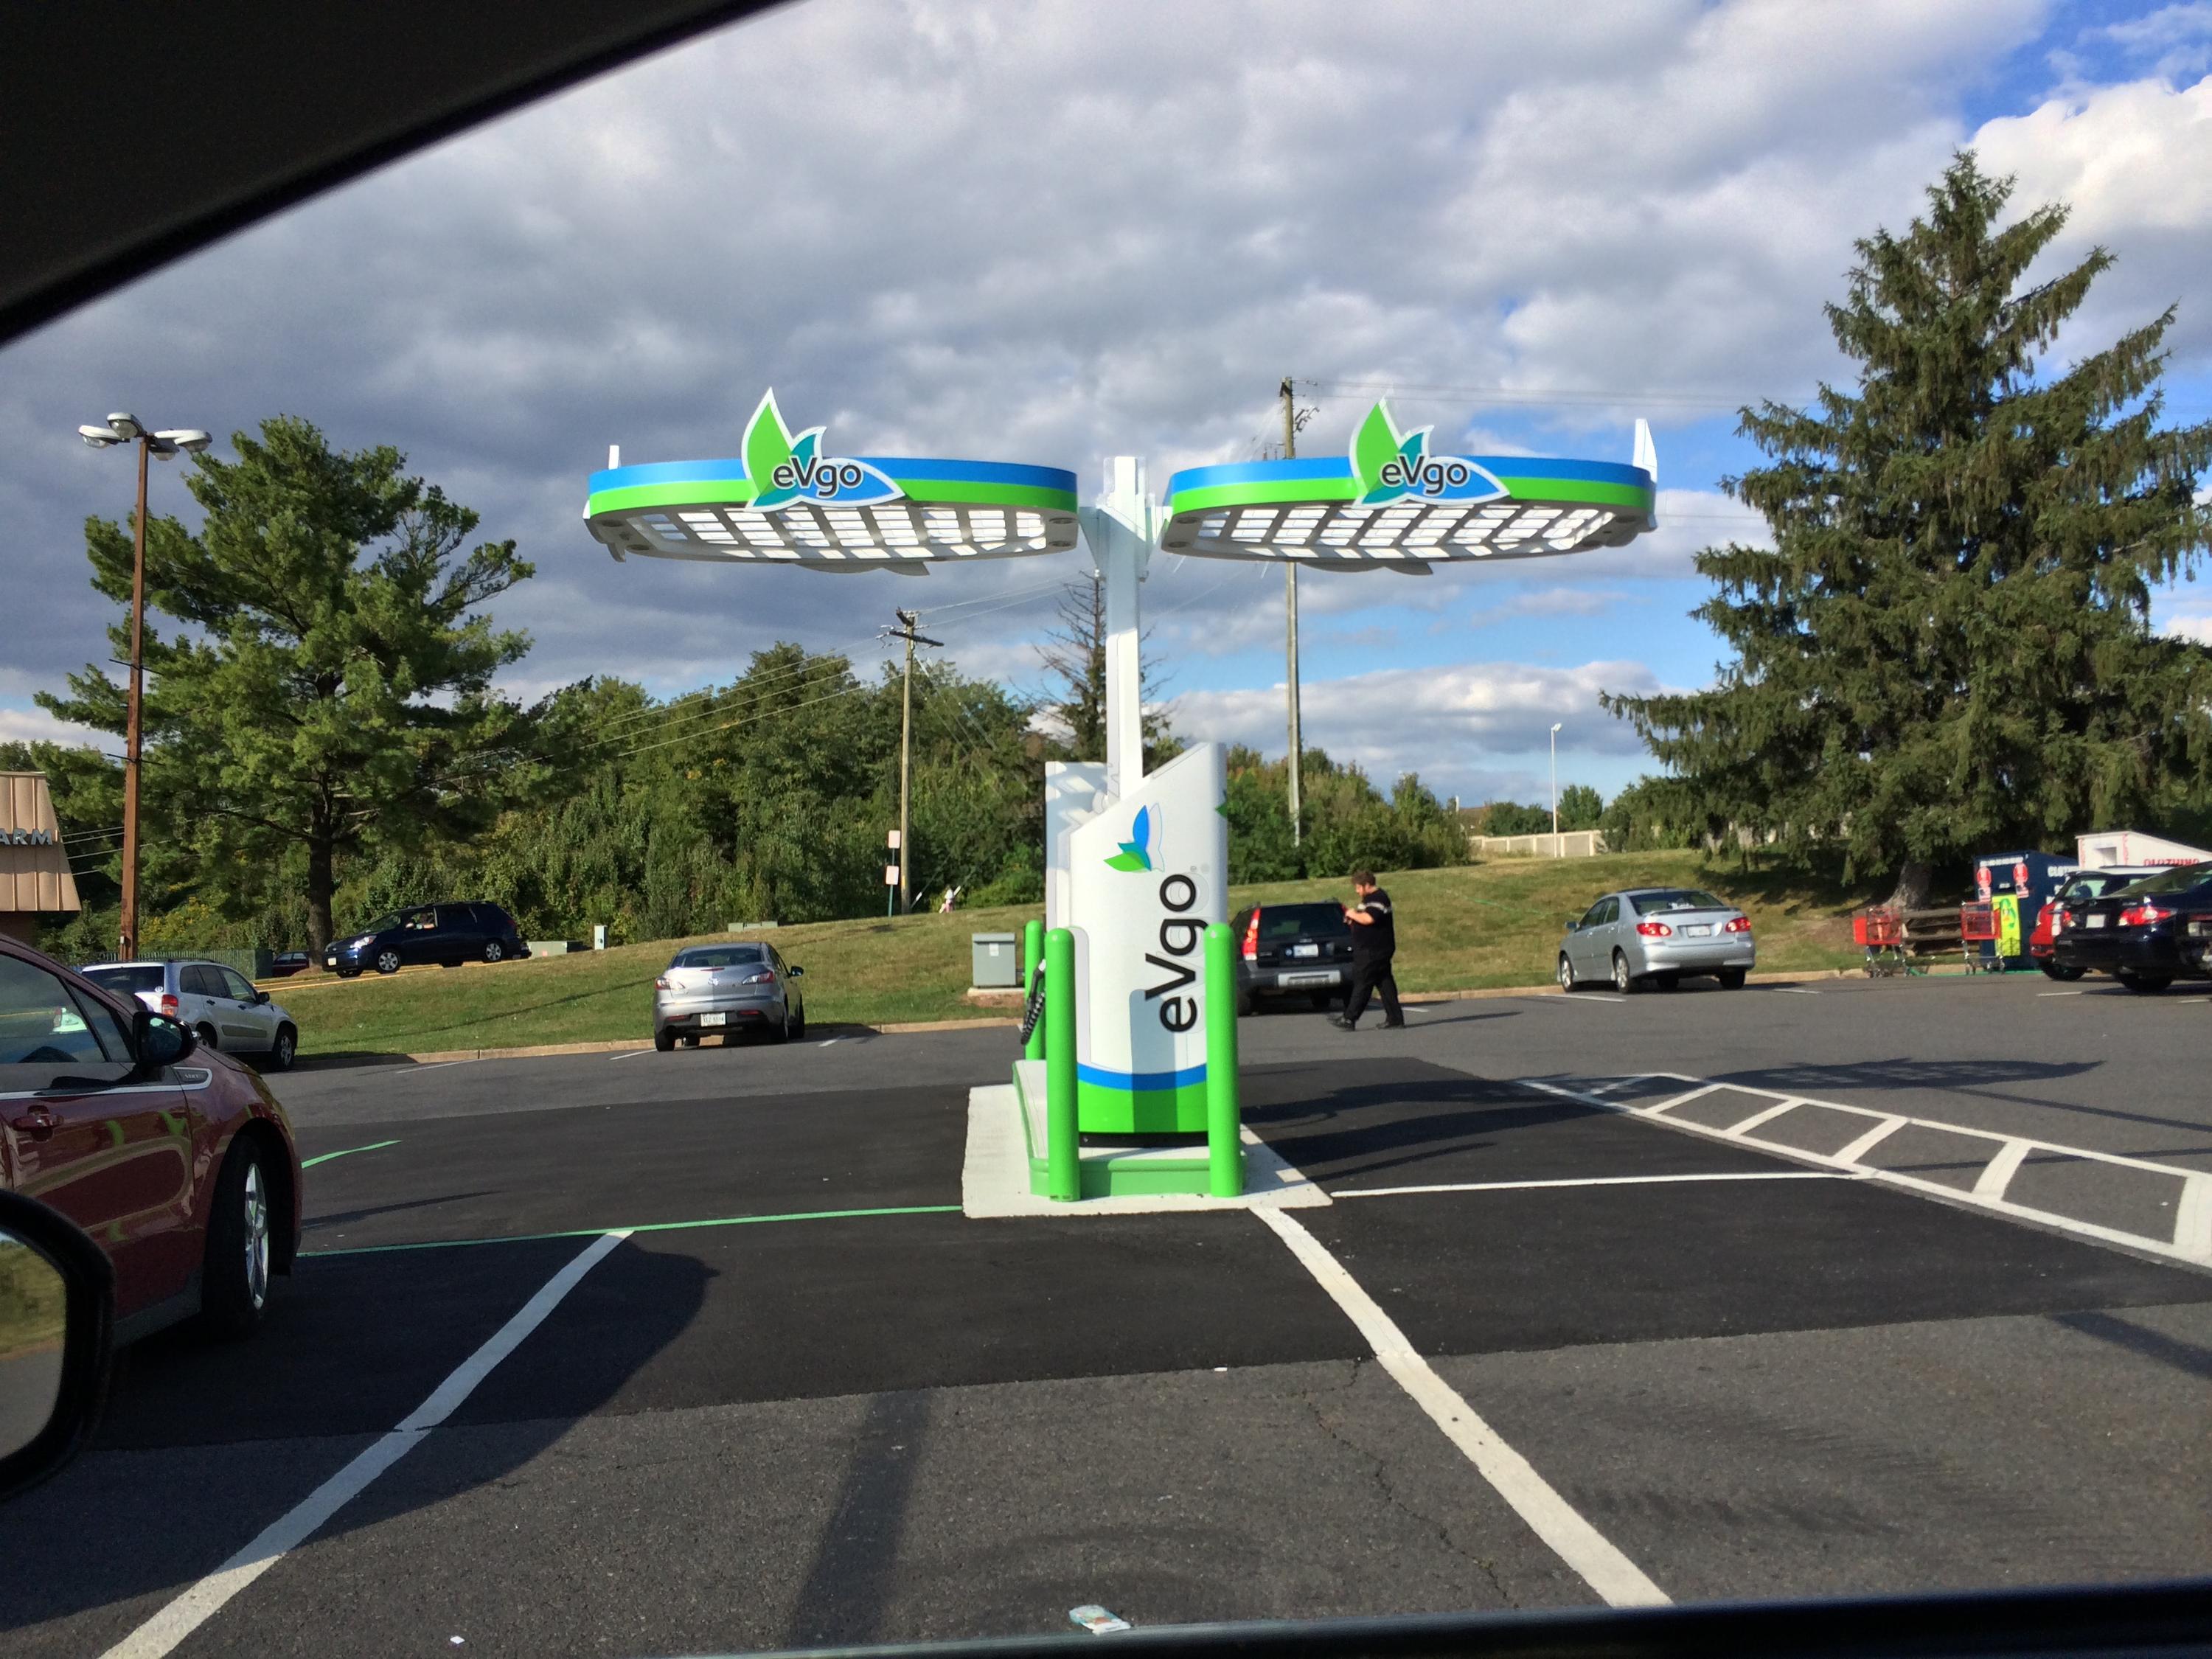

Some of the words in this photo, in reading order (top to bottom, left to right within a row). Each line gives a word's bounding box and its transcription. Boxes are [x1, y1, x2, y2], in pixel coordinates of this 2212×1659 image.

[773, 457, 861, 496] eVgo
[1382, 456, 1467, 495] eVgo
[1145, 874, 1208, 1034] eVgo
